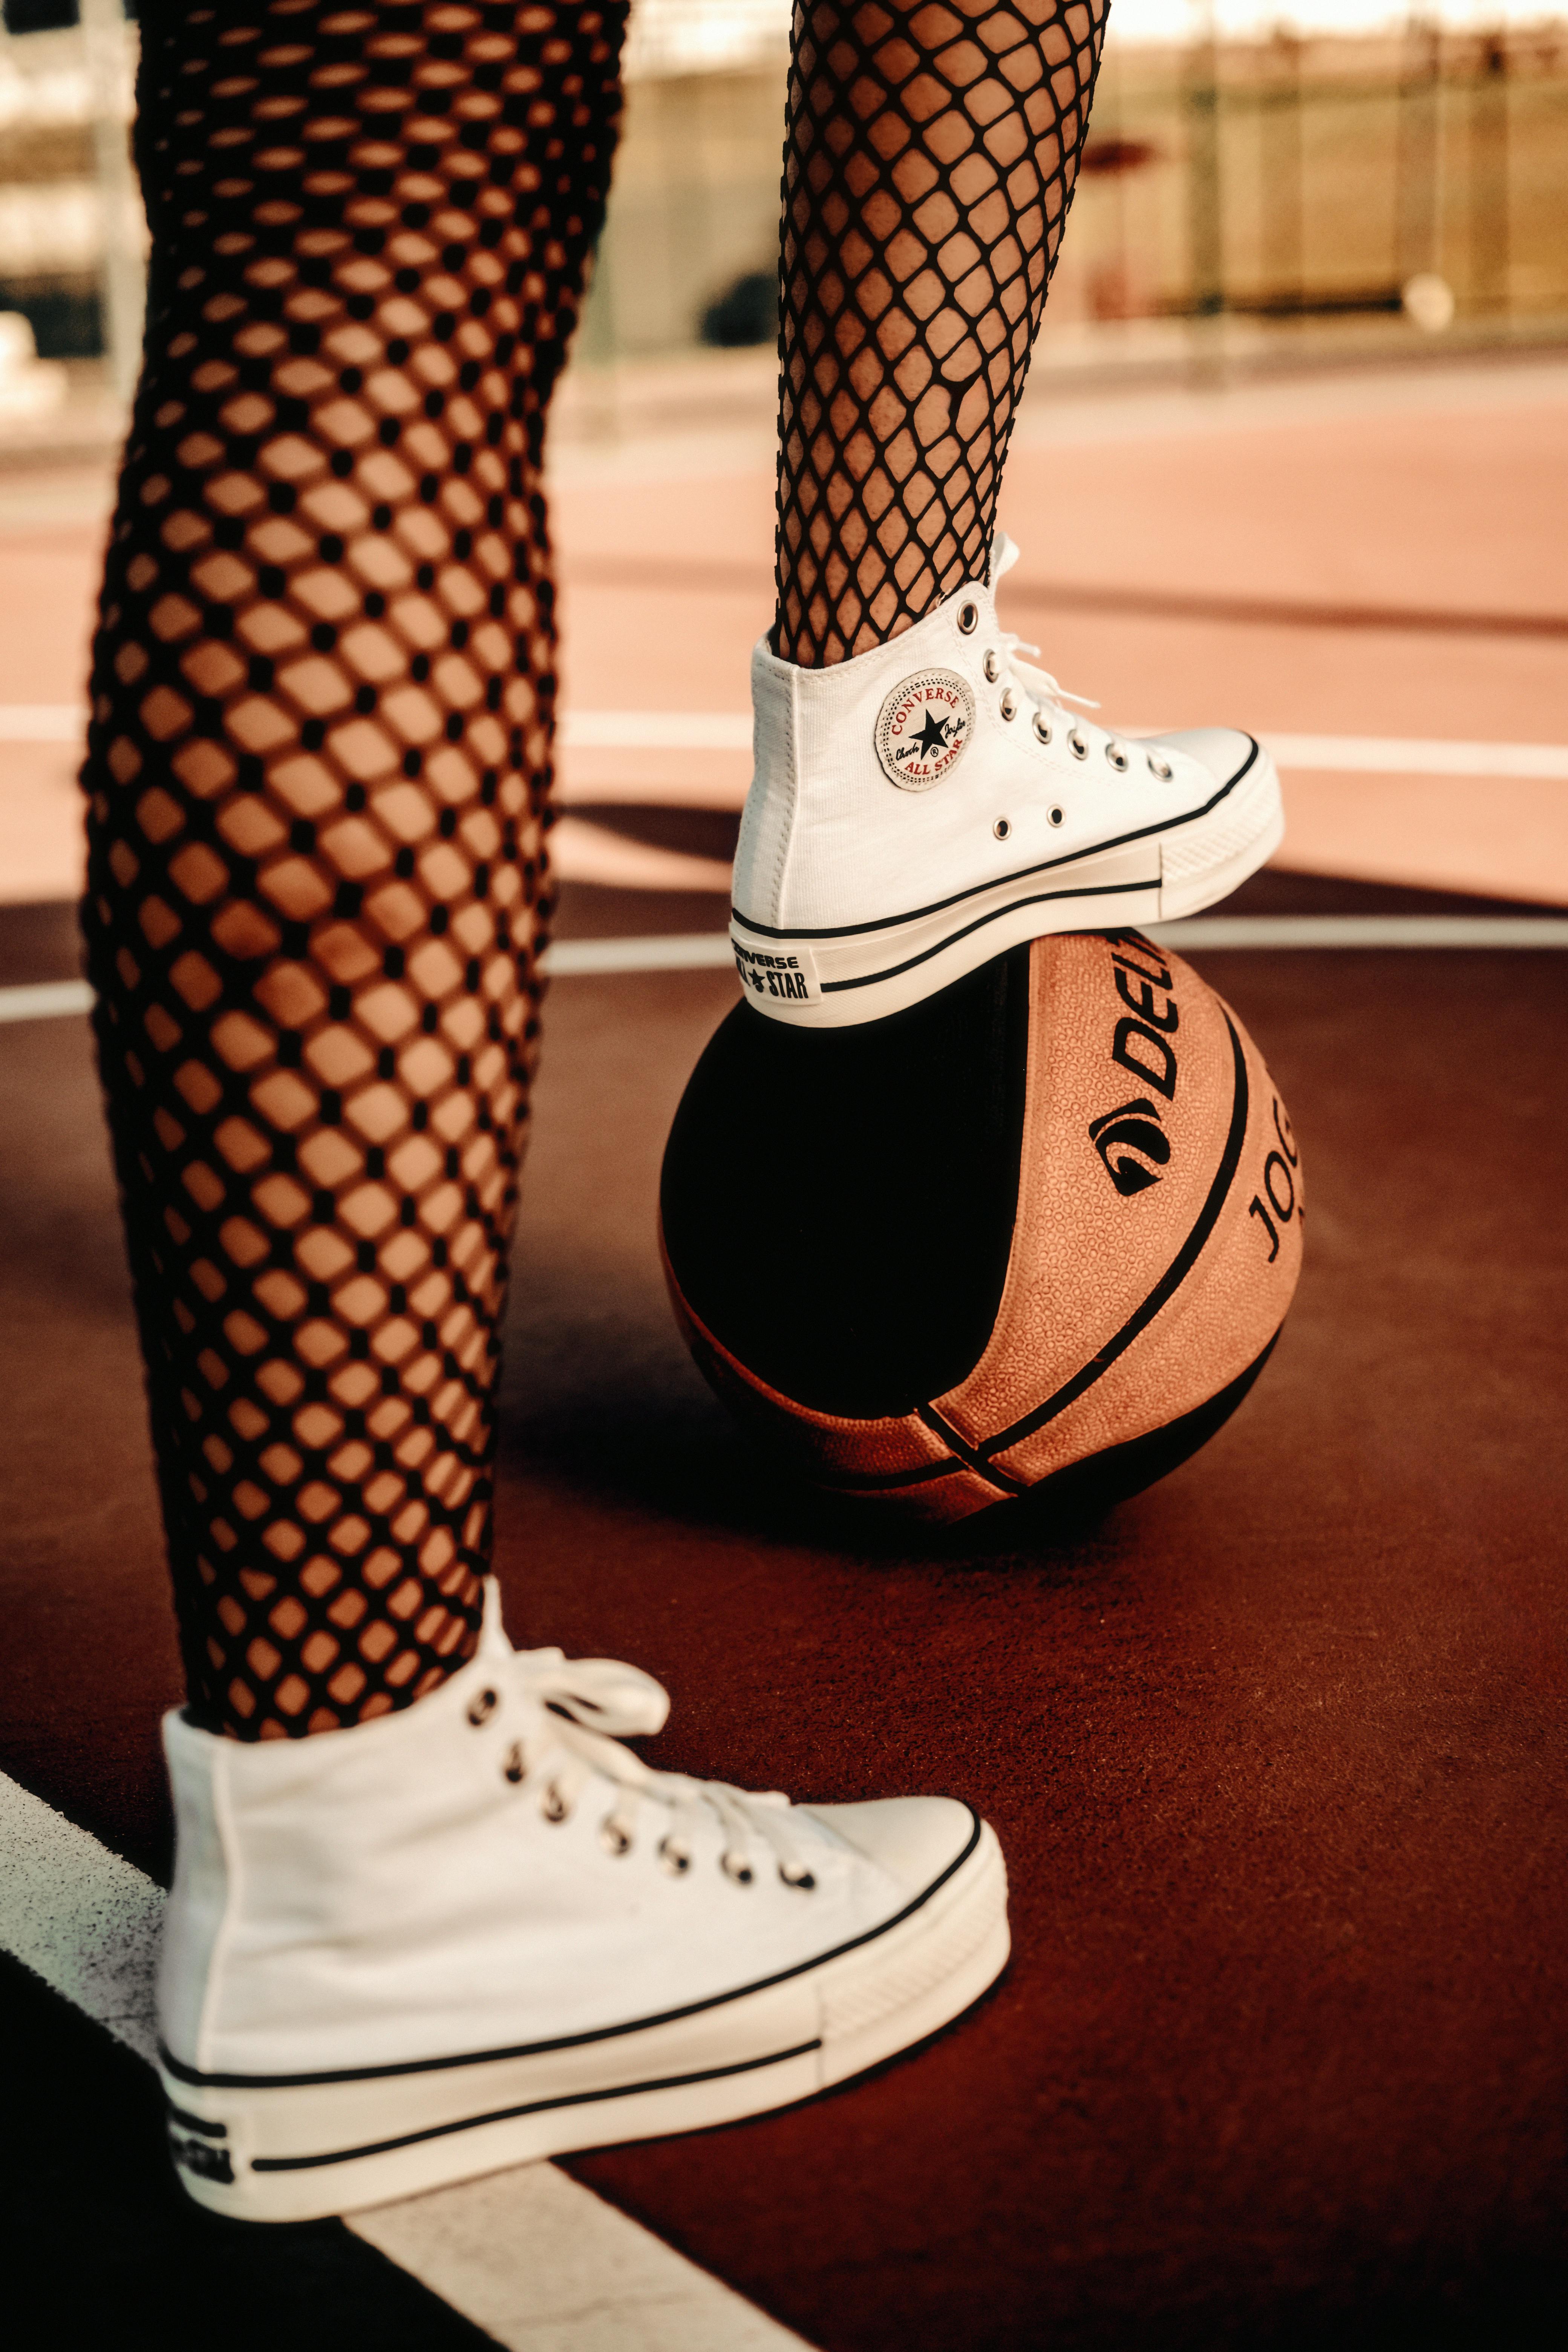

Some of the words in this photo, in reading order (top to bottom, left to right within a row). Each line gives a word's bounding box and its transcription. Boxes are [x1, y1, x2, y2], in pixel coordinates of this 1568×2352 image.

[891, 688, 959, 735] CONVERSE
[905, 762, 931, 775] ALL
[935, 739, 962, 771] STAR
[766, 971, 808, 998] STAR
[1106, 931, 1179, 1101] DELT
